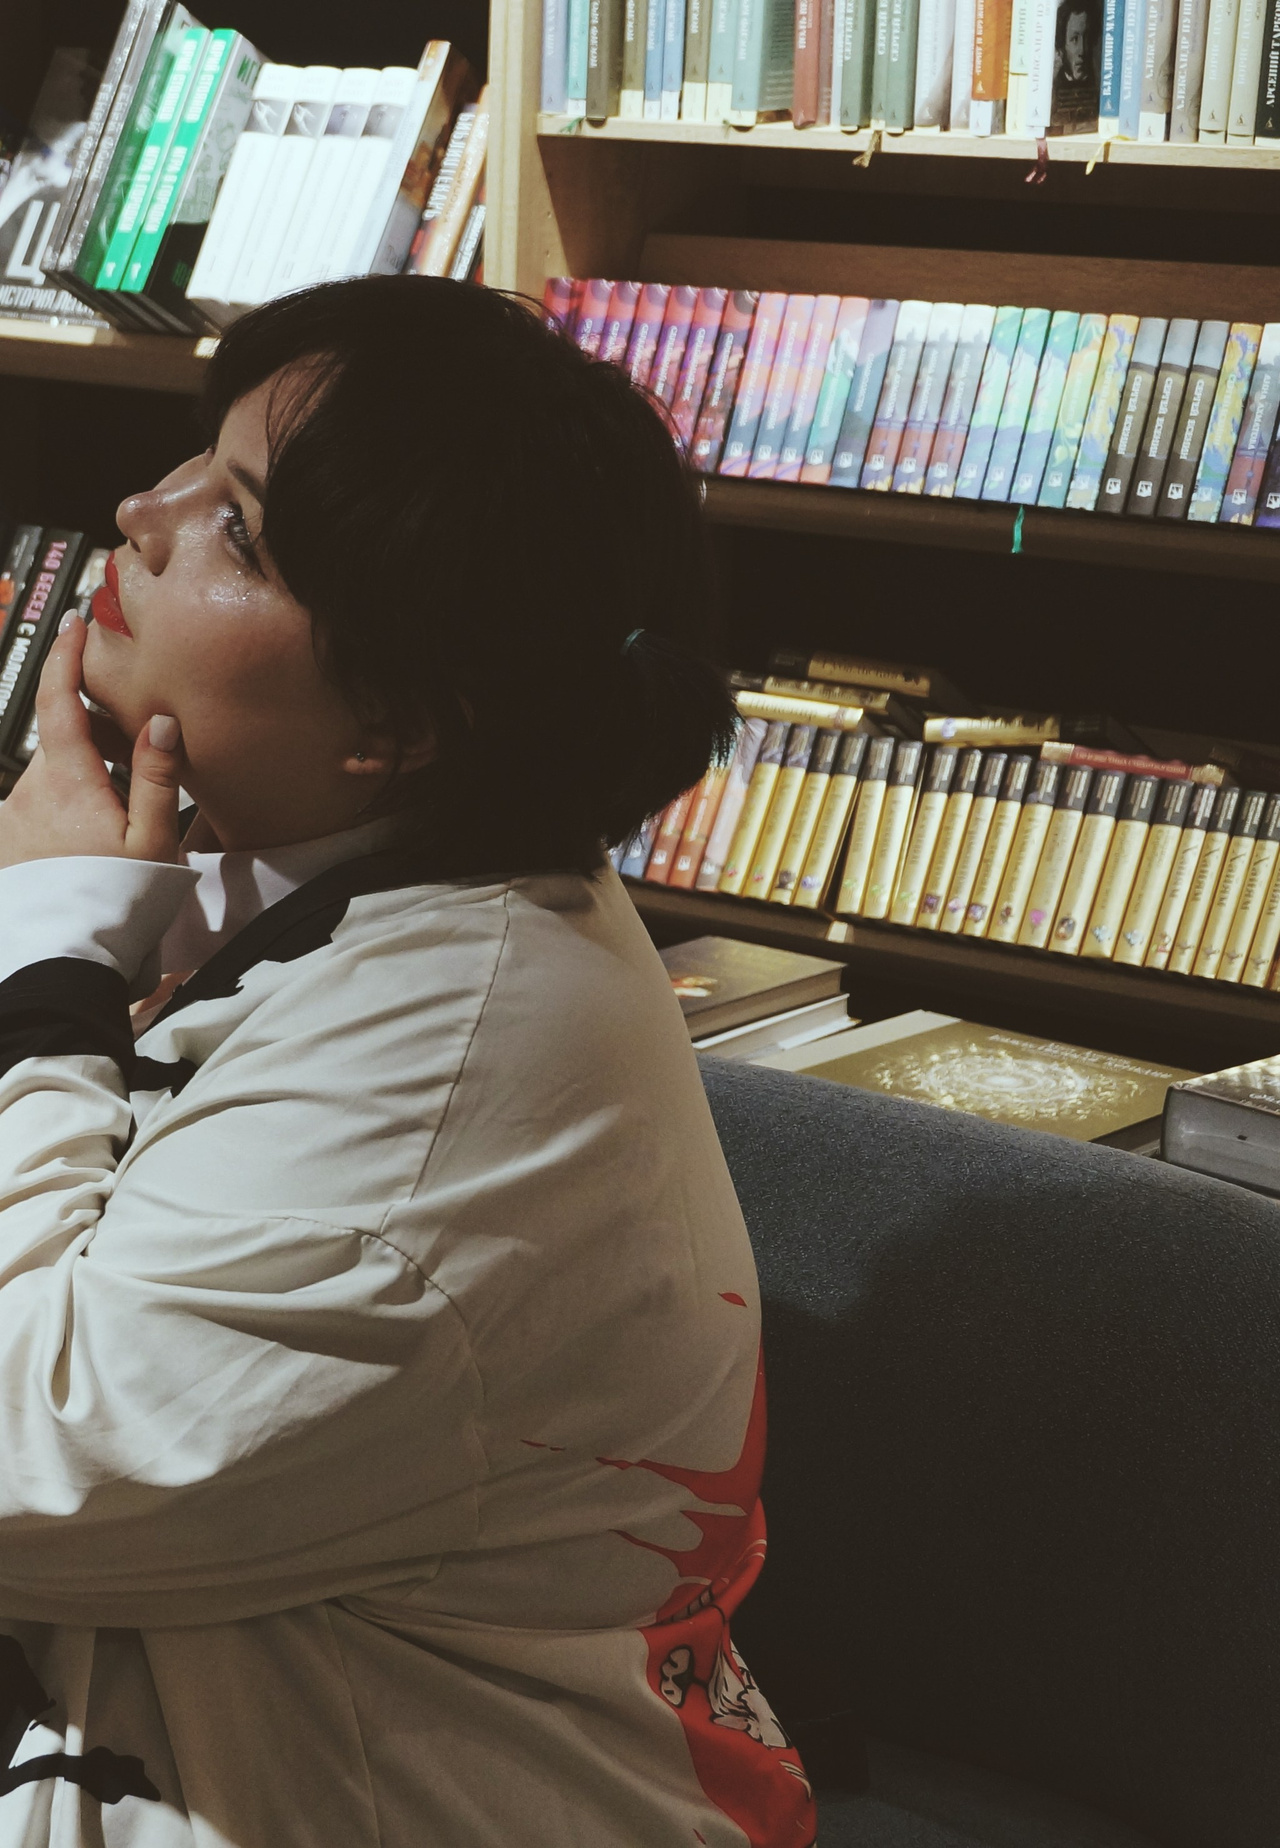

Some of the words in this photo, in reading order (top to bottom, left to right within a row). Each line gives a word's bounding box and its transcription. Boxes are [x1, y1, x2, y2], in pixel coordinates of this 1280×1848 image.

[588, 26, 600, 69] ИОСИФ
[843, 16, 854, 60] СЕРГЕЙ
[876, 10, 888, 55] СЕРГЕЙ
[889, 17, 902, 62] СЕРГЕЙ
[1017, 8, 1027, 45] ЮРИЙ
[1145, 5, 1158, 80] АЛЕКСАНДР
[175, 38, 199, 73] ЮРИЙ
[203, 38, 227, 72] ЮРИЙ
[1031, 21, 1044, 93] АЛЕКСАНДР
[1102, 33, 1115, 96] ВЛАДИМИР
[1123, 30, 1136, 100] АЛЕКСАНДР
[1176, 37, 1191, 110] АЛЕКСАНДР
[1209, 42, 1219, 80] БОРИС
[1238, 43, 1249, 85] БОРИС
[156, 72, 186, 124] СТОЯНОВ
[183, 71, 213, 124] СТОЯНОВ
[1266, 50, 1278, 107] АРСЕНИЙ
[86, 82, 111, 132] ГЕНРИ
[106, 82, 131, 132] ГЕНРИ
[71, 135, 94, 180] ФОРД
[90, 134, 114, 182] ФОРД
[894, 345, 907, 371] АННА
[926, 348, 939, 374] АННА
[958, 351, 971, 378] АННА
[885, 372, 901, 419] АХМАТОВА
[917, 375, 932, 421] АХМАТОВА
[949, 379, 964, 426] АХМАТОВА
[1127, 375, 1142, 411] СЕРГЕЙ
[1158, 377, 1173, 414] СЕРГЕЙ
[1190, 379, 1205, 416] СЕРГЕЙ
[1258, 373, 1271, 400] АННА
[1118, 414, 1133, 454] ЕСЕНИН
[1149, 416, 1165, 457] ЕСЕНИН
[1180, 419, 1196, 459] ЕСЕНИН
[1248, 401, 1264, 450] АХМАТОВА
[42, 537, 67, 571] 140
[22, 569, 55, 624] БЕСЕД
[18, 620, 36, 638] С
[1169, 842, 1197, 899] Хайям
[1190, 844, 1219, 904] Хайям
[1216, 849, 1245, 908] Хайям
[1240, 851, 1269, 912] Хайям
